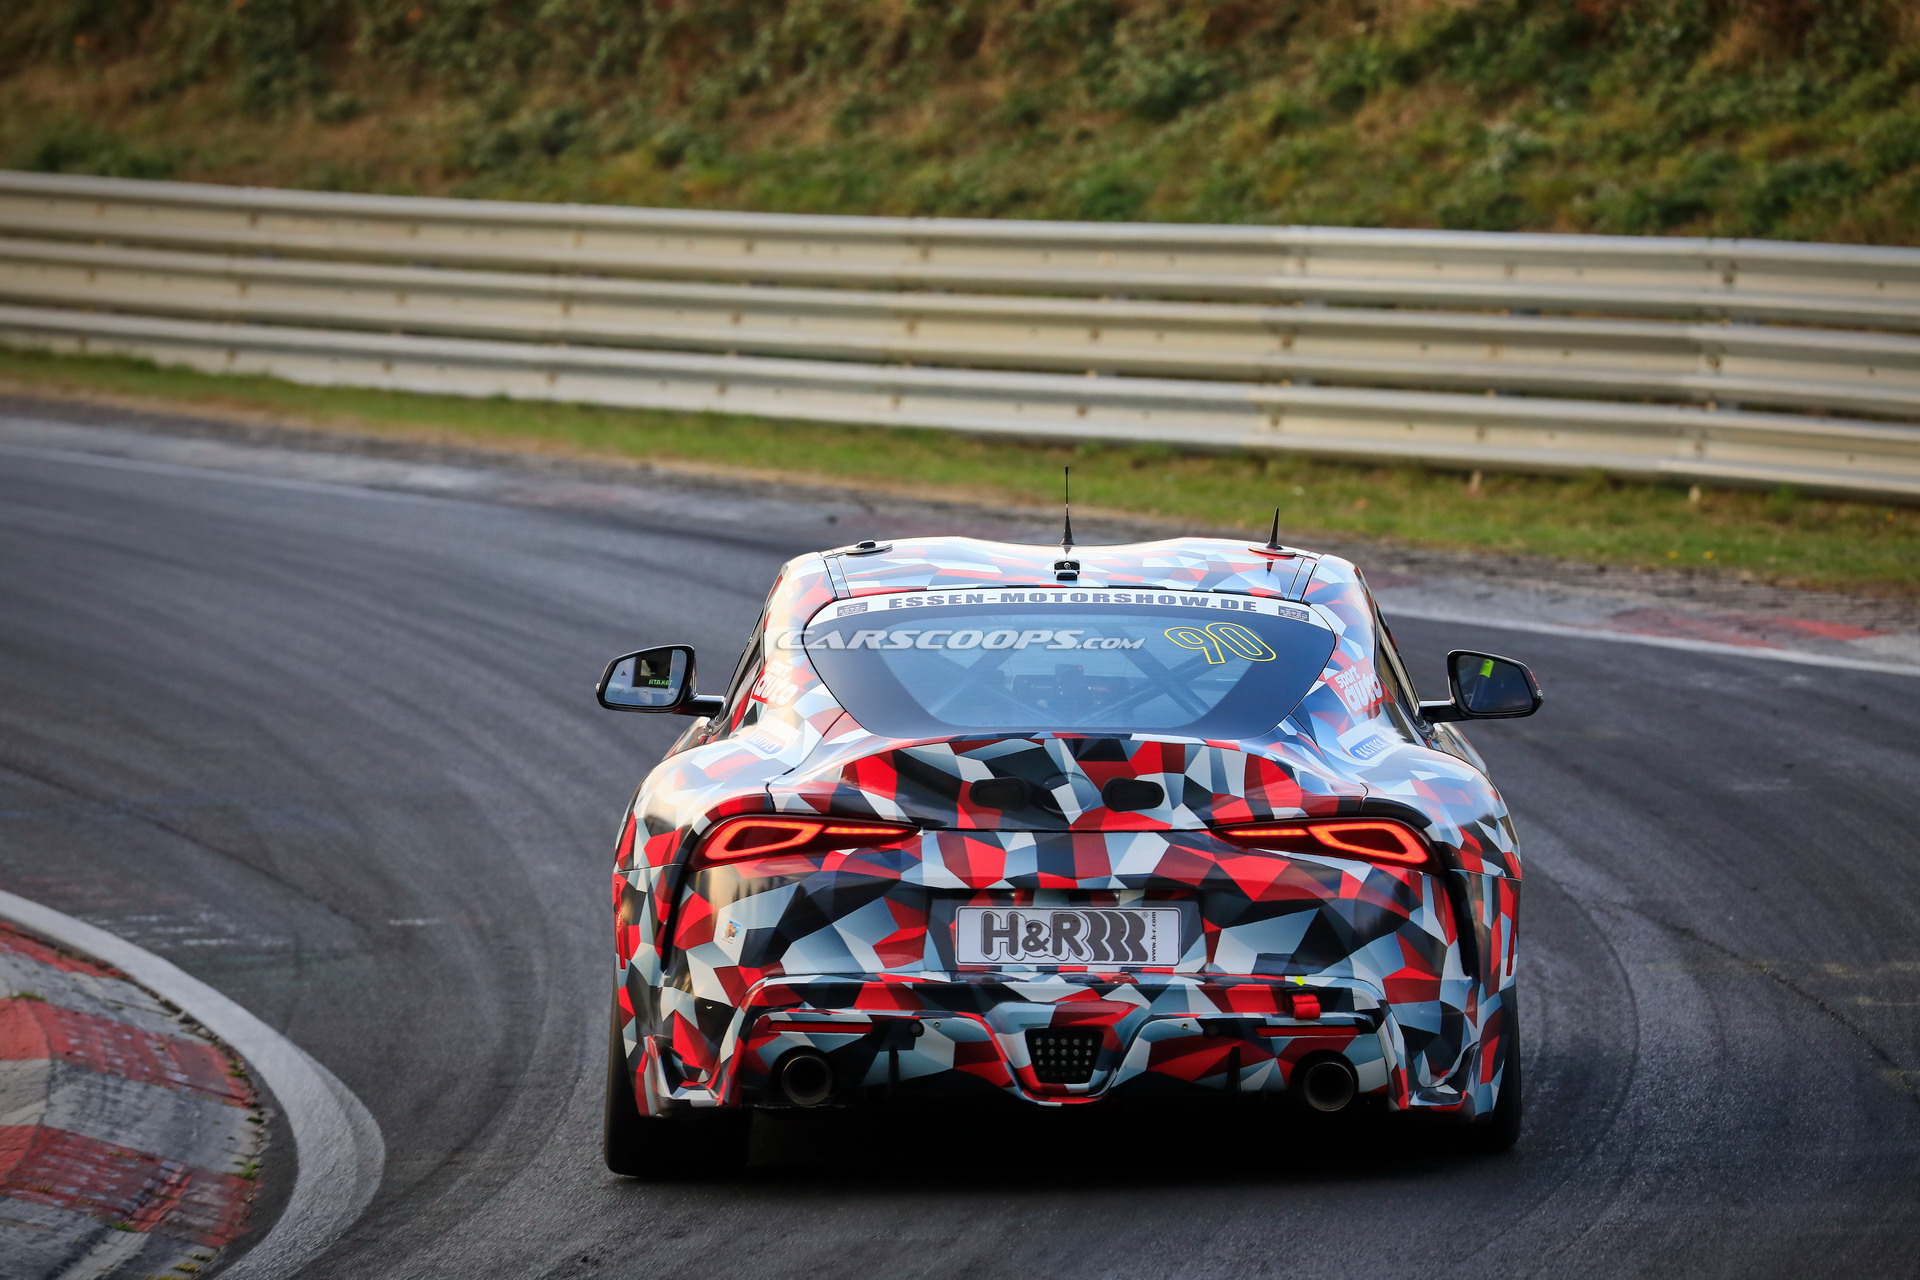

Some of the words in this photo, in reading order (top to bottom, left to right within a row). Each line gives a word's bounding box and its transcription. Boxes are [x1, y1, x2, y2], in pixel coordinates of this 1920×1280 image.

[889, 591, 1257, 611] ESSEN-MOTORSHOW.DE
[1164, 622, 1277, 665] 90
[1335, 664, 1361, 689] sport
[1344, 672, 1384, 713] auto
[981, 910, 1092, 962] H&R
